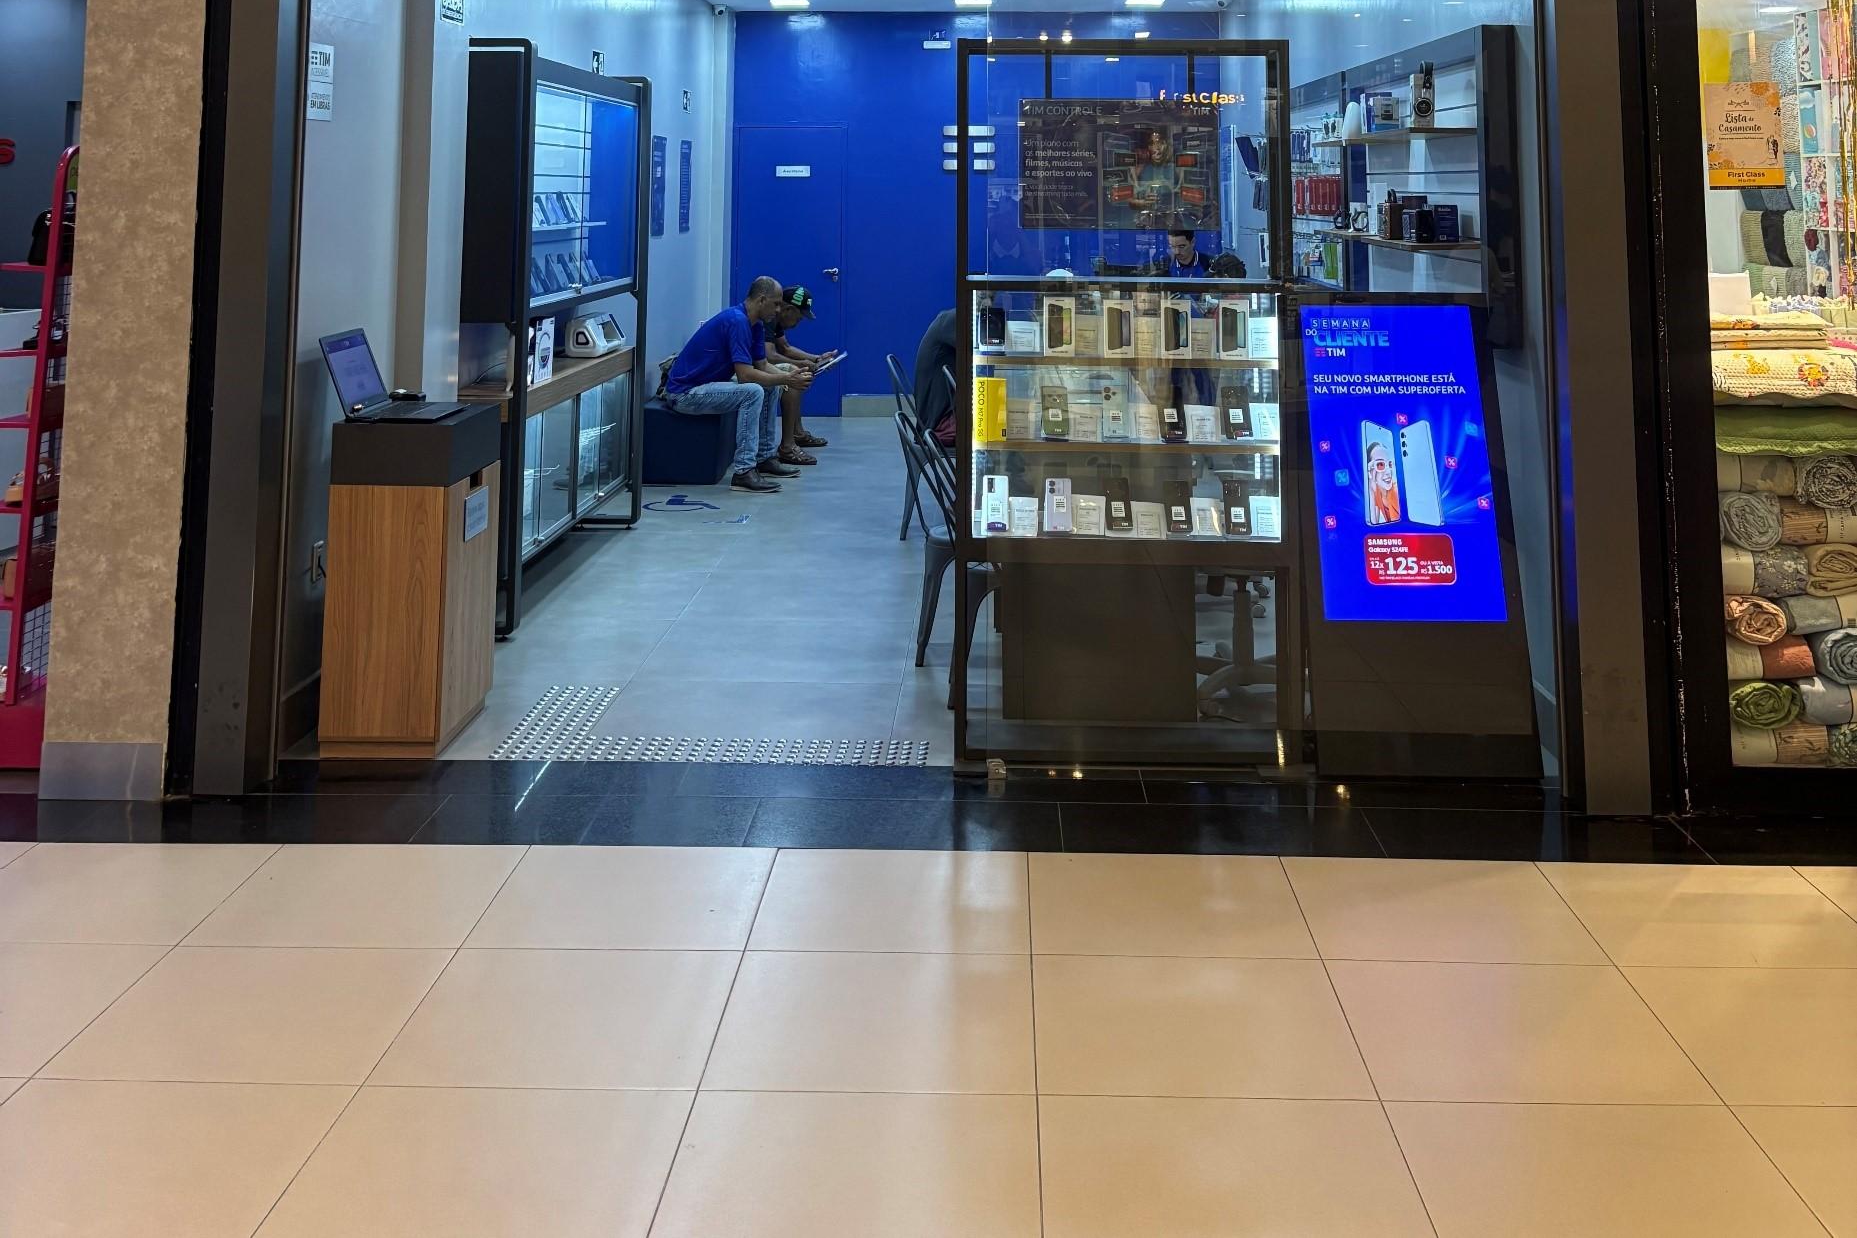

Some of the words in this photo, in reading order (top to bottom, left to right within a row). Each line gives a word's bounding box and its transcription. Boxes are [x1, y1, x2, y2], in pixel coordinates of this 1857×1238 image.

[319, 51, 331, 67] TIM
[1724, 112, 1747, 124] Lista
[1718, 123, 1762, 133] Casamento
[1035, 148, 1070, 157] melhores
[1311, 319, 1370, 328] SEMANA
[1313, 330, 1389, 347] CLIENTE
[1326, 347, 1346, 357] TIM
[1313, 374, 1332, 383] SEU
[1334, 374, 1362, 383] NOVO
[1364, 374, 1429, 383] SMARTPHONE
[1431, 372, 1456, 383] ESTÁ
[977, 381, 985, 406] POCO
[1314, 385, 1328, 394] NA
[1330, 385, 1347, 394] TIM
[1350, 385, 1371, 394] COM
[1374, 385, 1396, 394] UMA
[1398, 385, 1466, 394] SUPEROFERTA
[1367, 538, 1402, 546] SAMSUNG
[1368, 547, 1390, 555] Galaxy
[1370, 561, 1384, 569] 12x
[1385, 557, 1418, 575] 125
